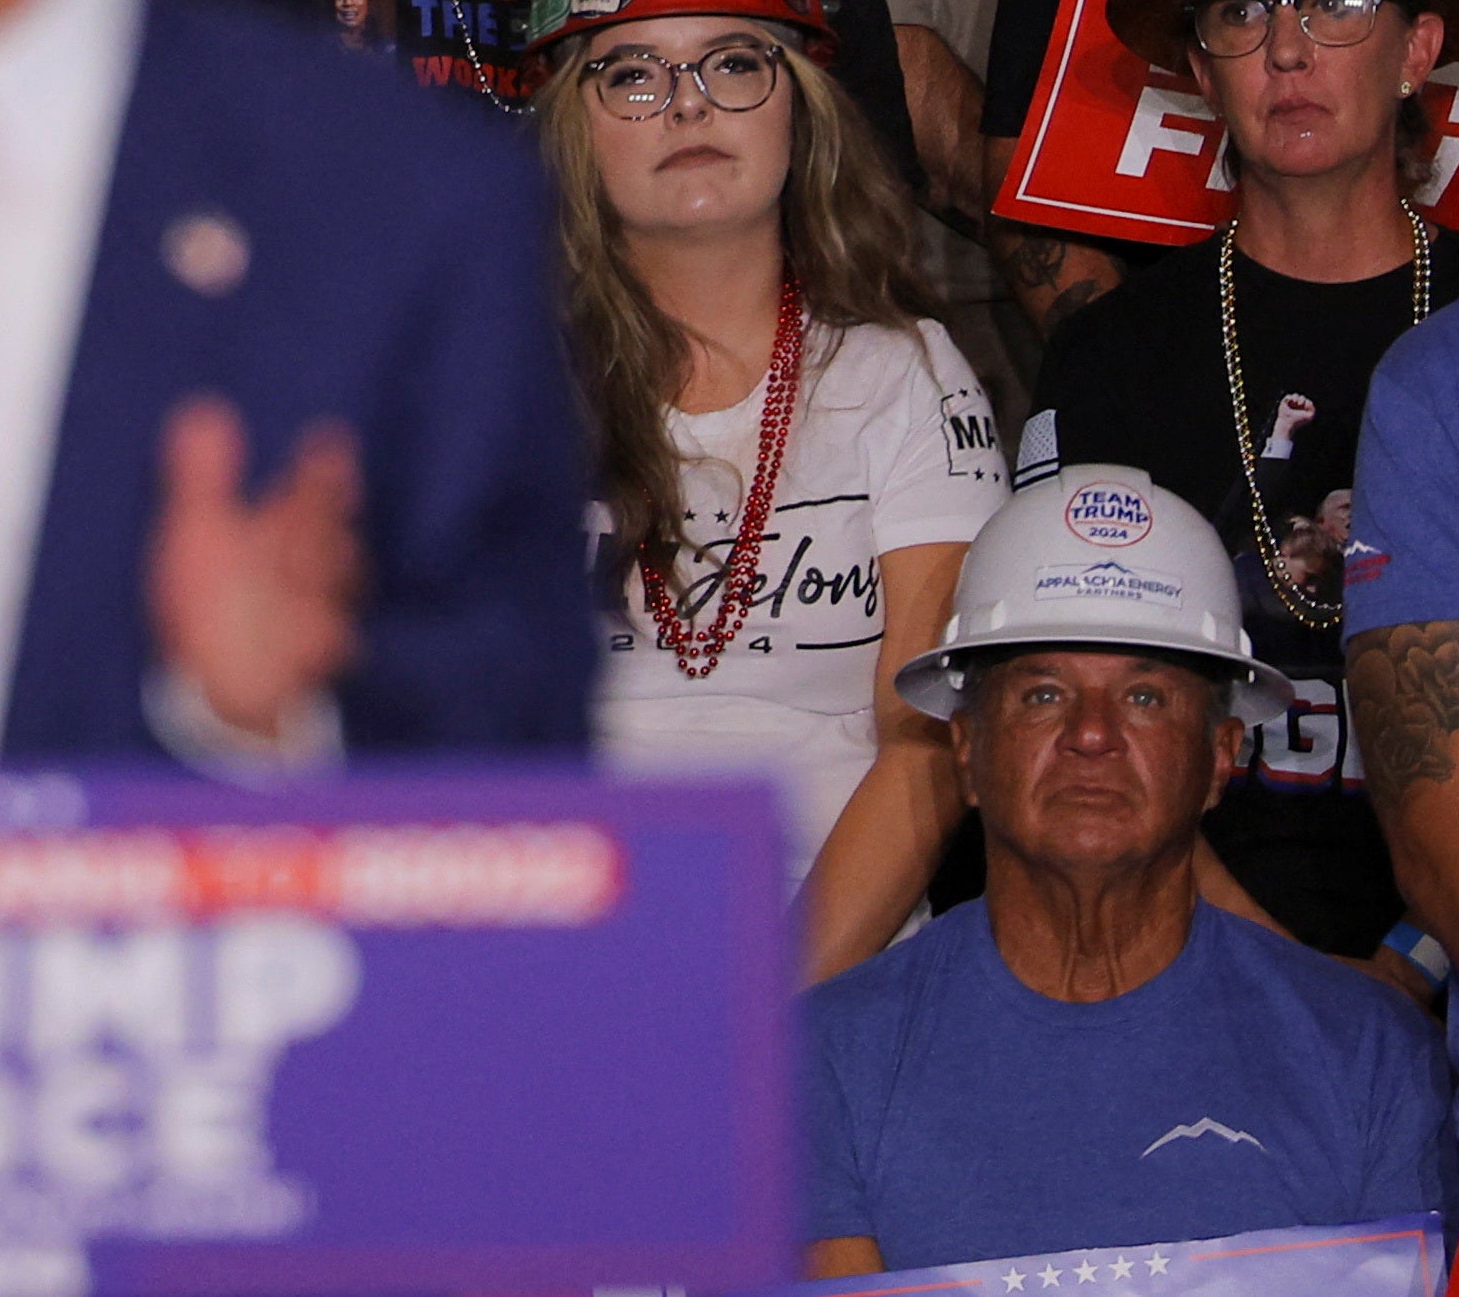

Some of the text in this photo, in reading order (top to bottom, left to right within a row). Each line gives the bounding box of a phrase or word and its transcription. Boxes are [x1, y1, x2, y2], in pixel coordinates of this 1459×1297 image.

[1079, 491, 1141, 511] TEAM
[1070, 505, 1149, 524] TRUMP
[1089, 527, 1128, 540] 2024
[676, 534, 880, 620] Felons
[1035, 574, 1183, 598] APPALACHIA ENERGY
[1076, 588, 1144, 601] PARTNERS
